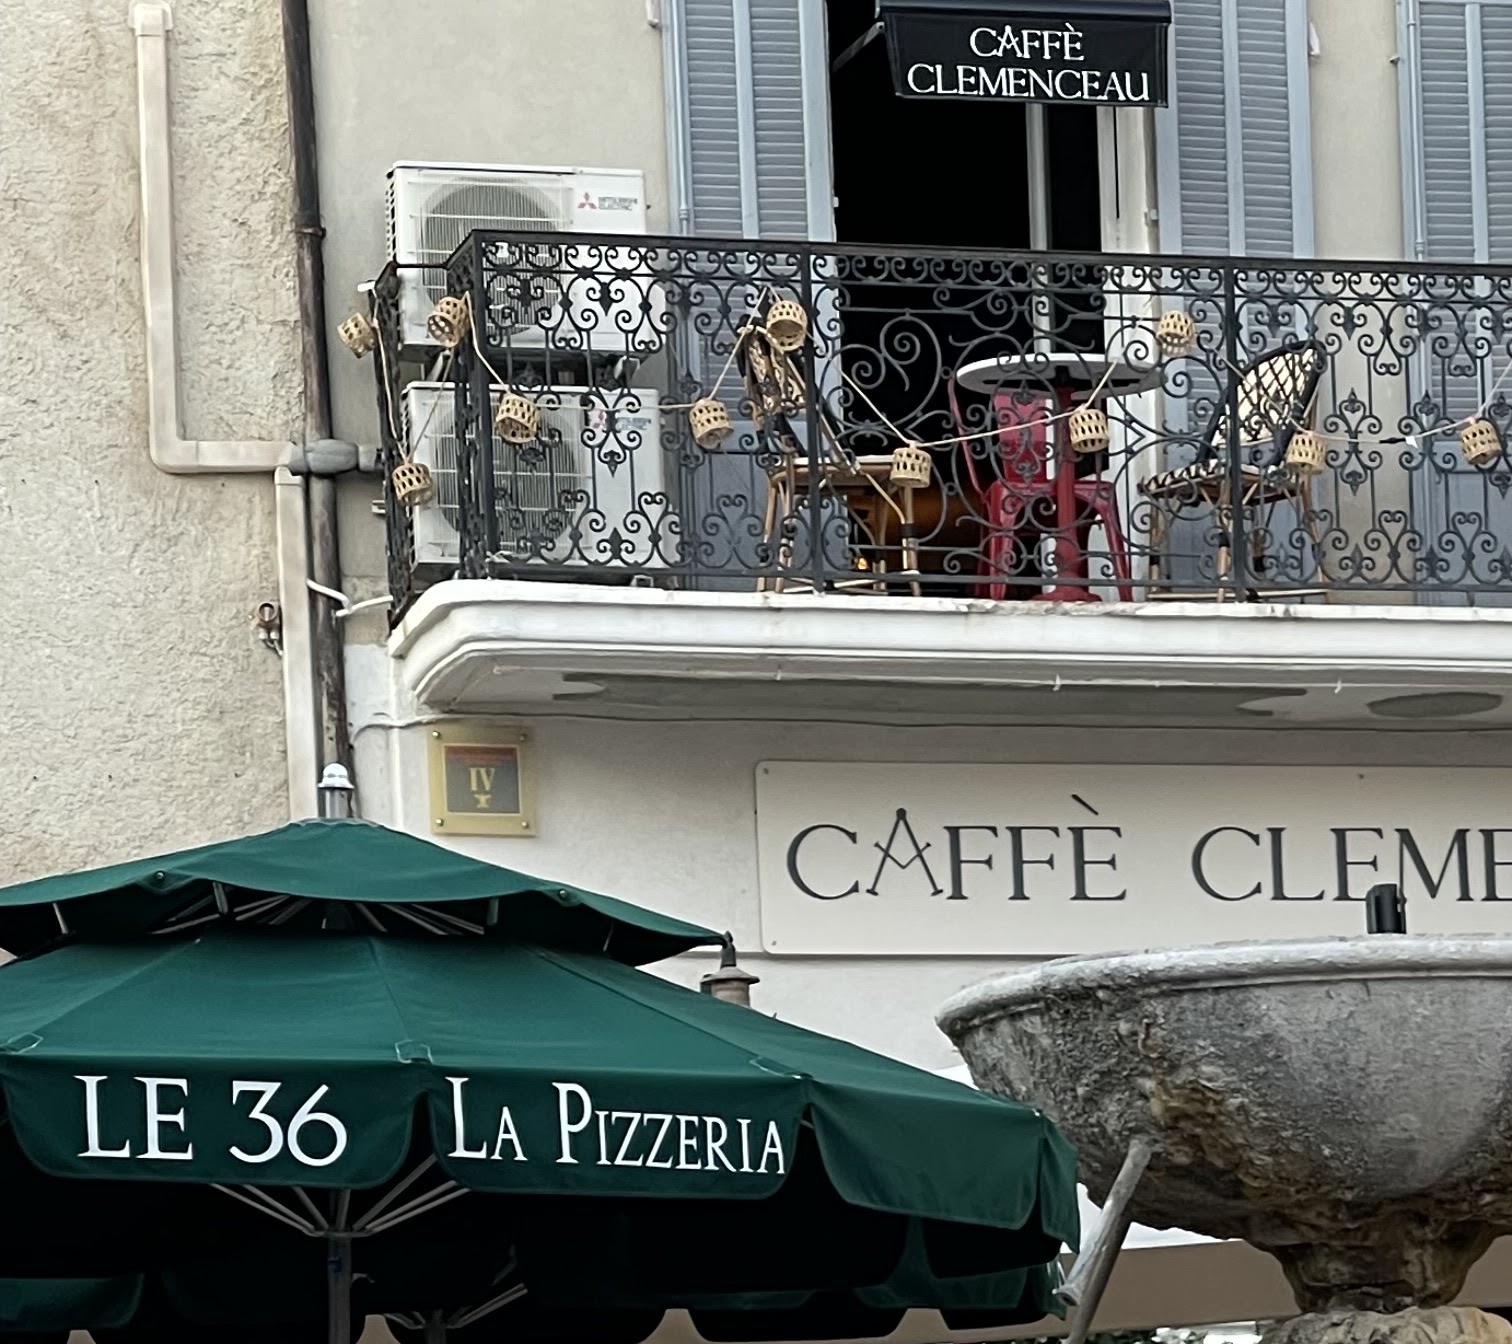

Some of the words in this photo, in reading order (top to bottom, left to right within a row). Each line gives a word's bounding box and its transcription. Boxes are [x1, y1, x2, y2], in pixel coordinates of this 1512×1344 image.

[969, 22, 1085, 61] CAFFÈ
[907, 63, 1150, 101] CLEMENCEAU
[786, 794, 1128, 901] CAFFÈ
[74, 1075, 194, 1162] LE
[228, 1080, 349, 1168] 36
